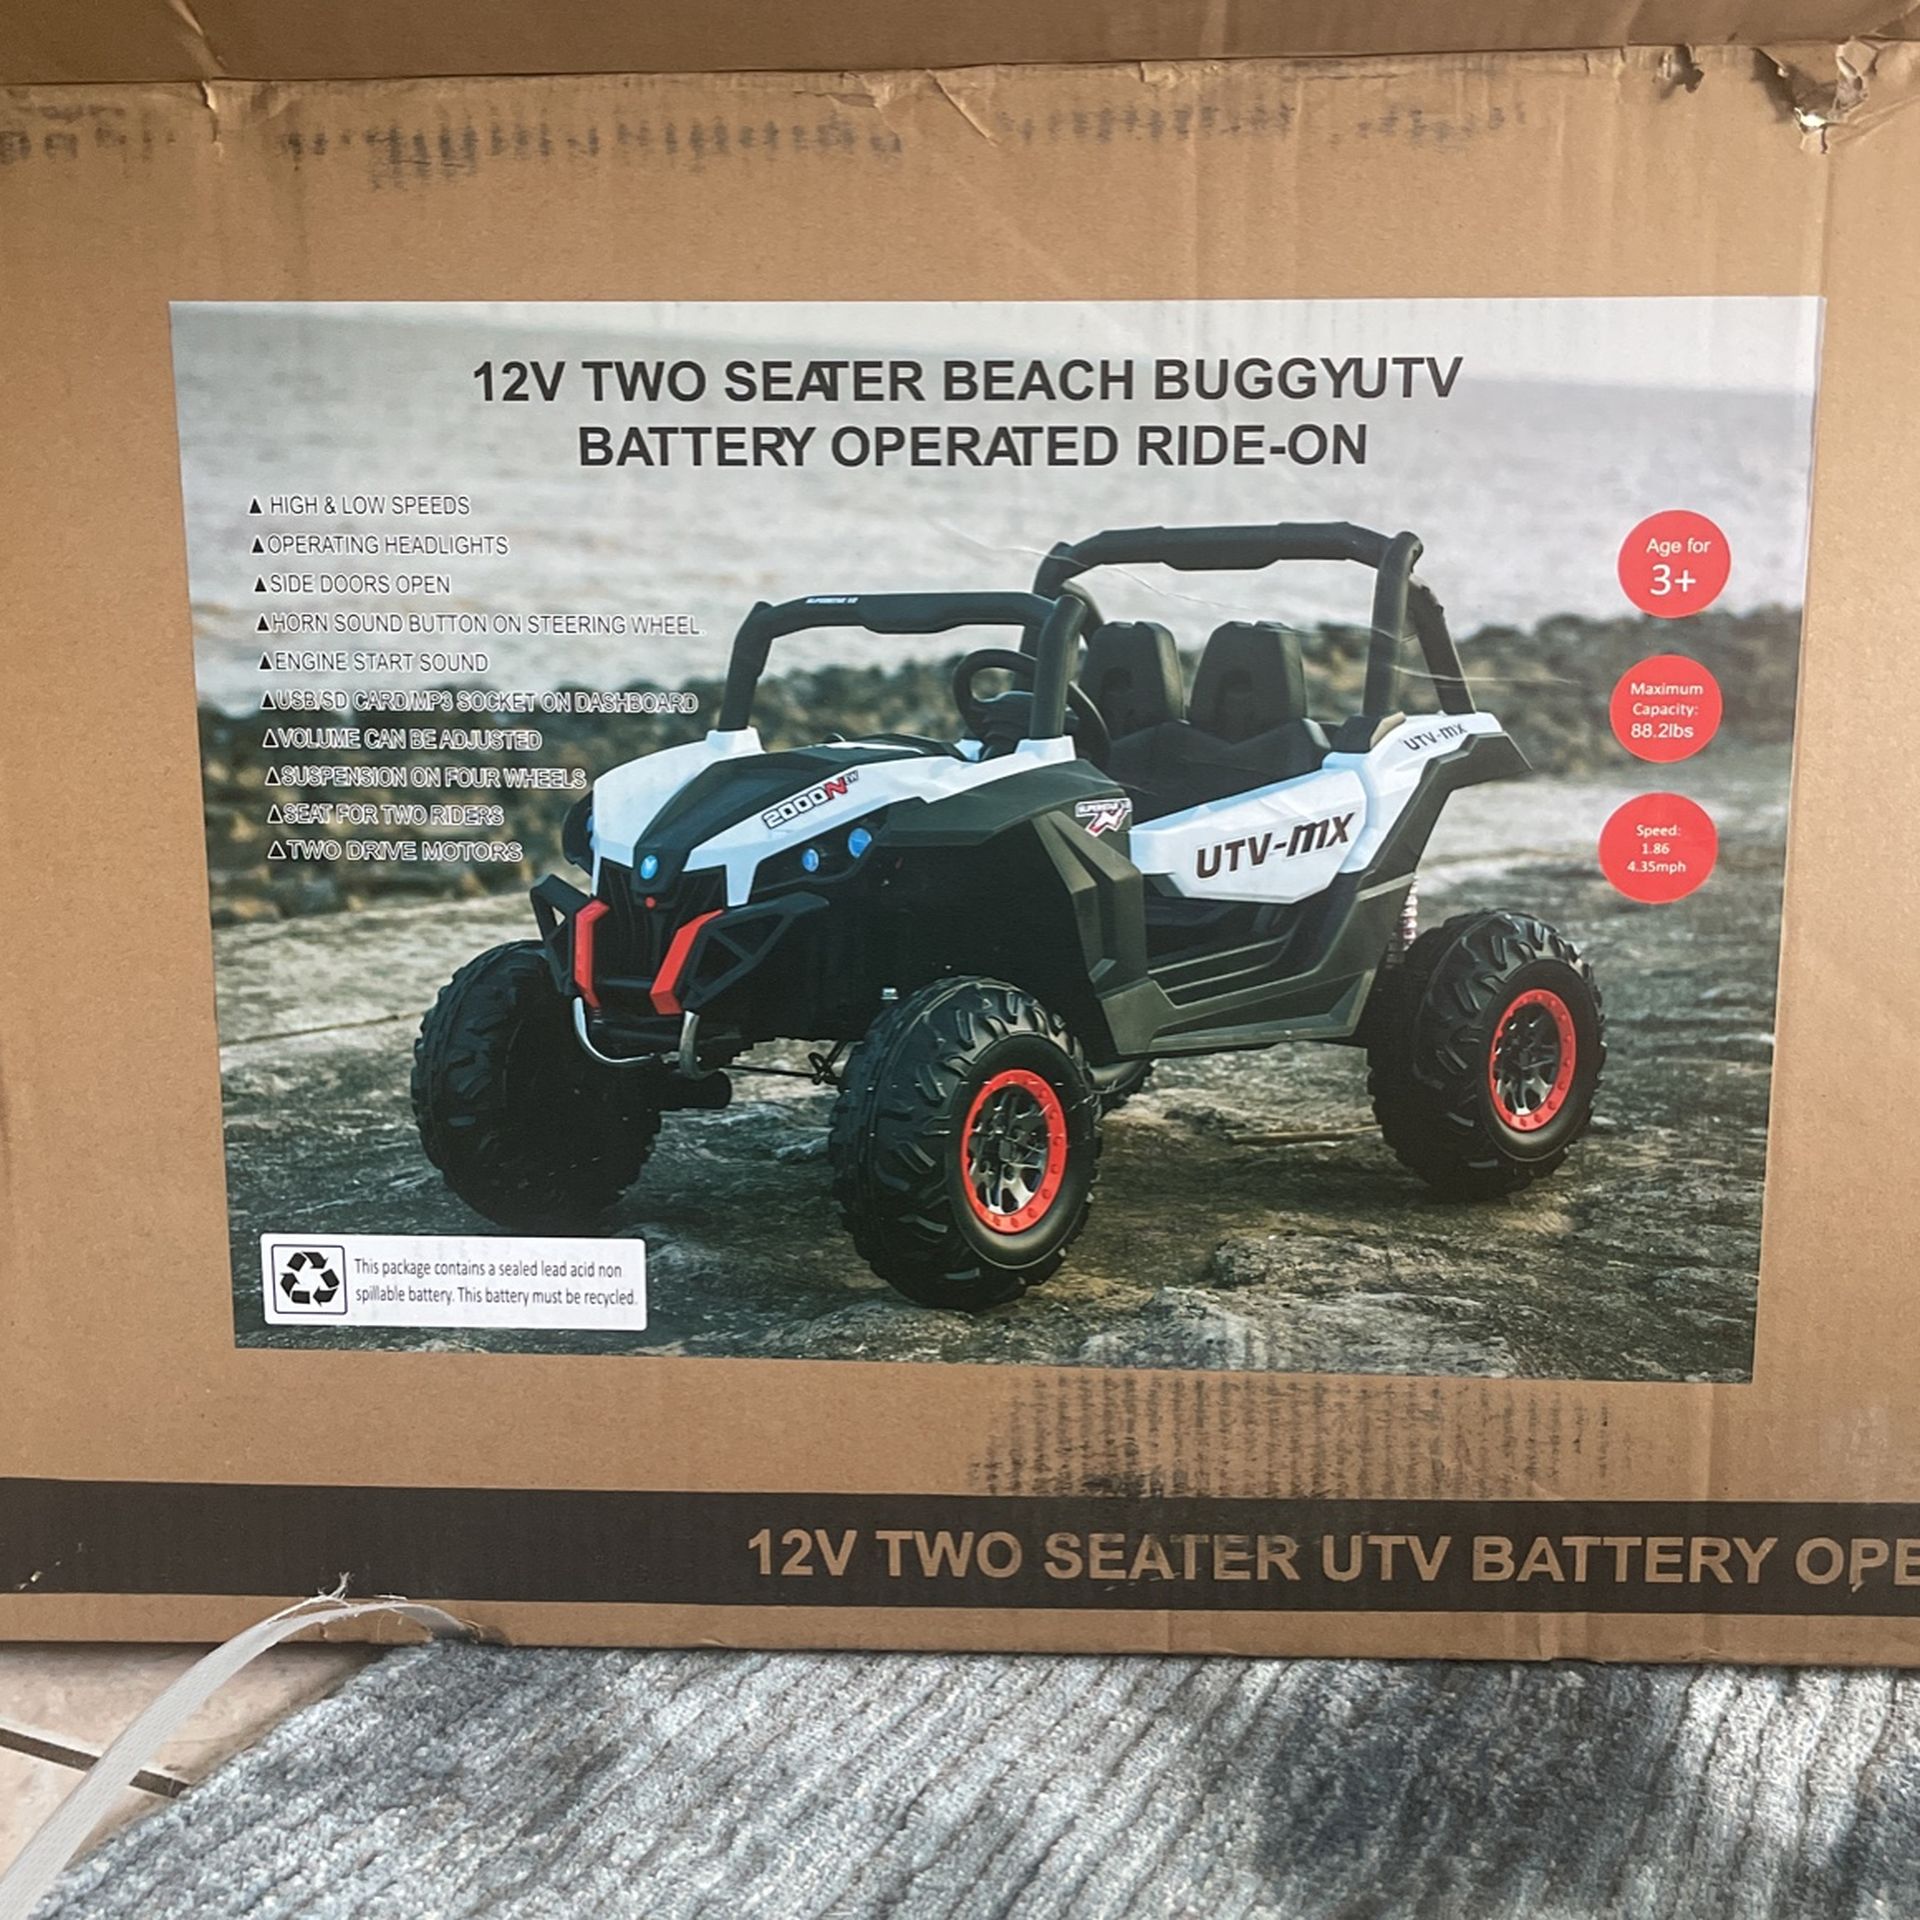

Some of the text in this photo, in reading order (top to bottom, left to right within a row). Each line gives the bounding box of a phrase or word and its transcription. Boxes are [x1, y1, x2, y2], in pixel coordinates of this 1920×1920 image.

[474, 356, 1464, 402] 12V TWO SEATER BEACH BUGGYUTV
[579, 424, 1367, 467] BATTERY OPERATED RIDE-ON
[270, 496, 470, 516] HIGH & LOW SPEEDS
[267, 535, 509, 556] OPERATING HEADLIGHTS
[1646, 537, 1711, 557] Age for
[270, 574, 451, 595] SIDE DOORS OPEN
[1649, 563, 1696, 596] 3+
[272, 613, 329, 634] HORN
[334, 613, 403, 634] SOUND
[409, 614, 488, 635] BUTTON
[492, 614, 522, 635] ON
[527, 614, 626, 635] STEERING
[275, 652, 489, 673] ENGINE START SOUND
[1630, 682, 1704, 695] Maximum
[457, 690, 535, 712] SOCKET
[541, 692, 571, 713] ON
[575, 692, 699, 714] DASHBOARD
[1632, 702, 1699, 717] Capacity:
[278, 728, 543, 751] VOLUME CAN BE ADJUSTED
[1631, 723, 1694, 738] 88.2lbs
[281, 765, 586, 789] SUSPENSION ON FOUR WHEELS
[283, 803, 504, 826] SEAT FOR TWO RIDERS
[1636, 824, 1681, 838] Speed:
[286, 840, 523, 862] TWO DRIVE MOTORS
[1642, 842, 1670, 855] 1.86
[1627, 860, 1686, 875] 4.35mph
[354, 1258, 622, 1278] This package contains a sealed lead acid non
[356, 1285, 639, 1308] spillable battery. This battery must be recycled.
[747, 1528, 1920, 1588] 12V TWO SEATER UTV BATTERY OPE
